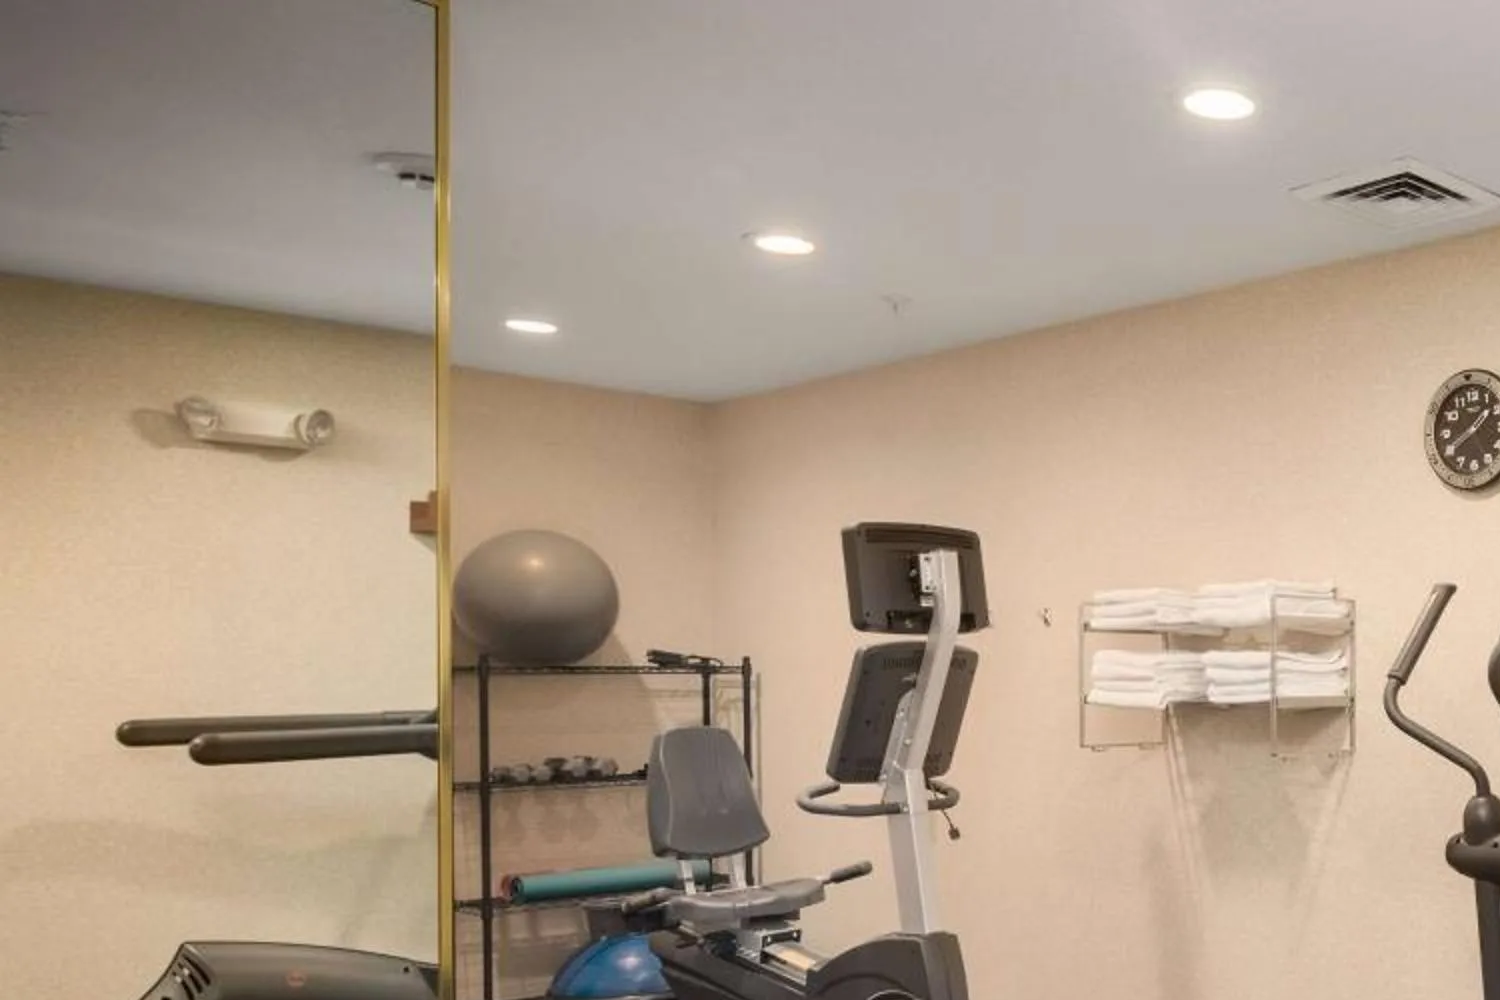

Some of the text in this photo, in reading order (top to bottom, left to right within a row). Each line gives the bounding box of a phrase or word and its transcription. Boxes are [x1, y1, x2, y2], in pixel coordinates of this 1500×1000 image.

[1455, 396, 1465, 407] 11
[1466, 390, 1479, 402] 12
[1484, 393, 1489, 403] 1
